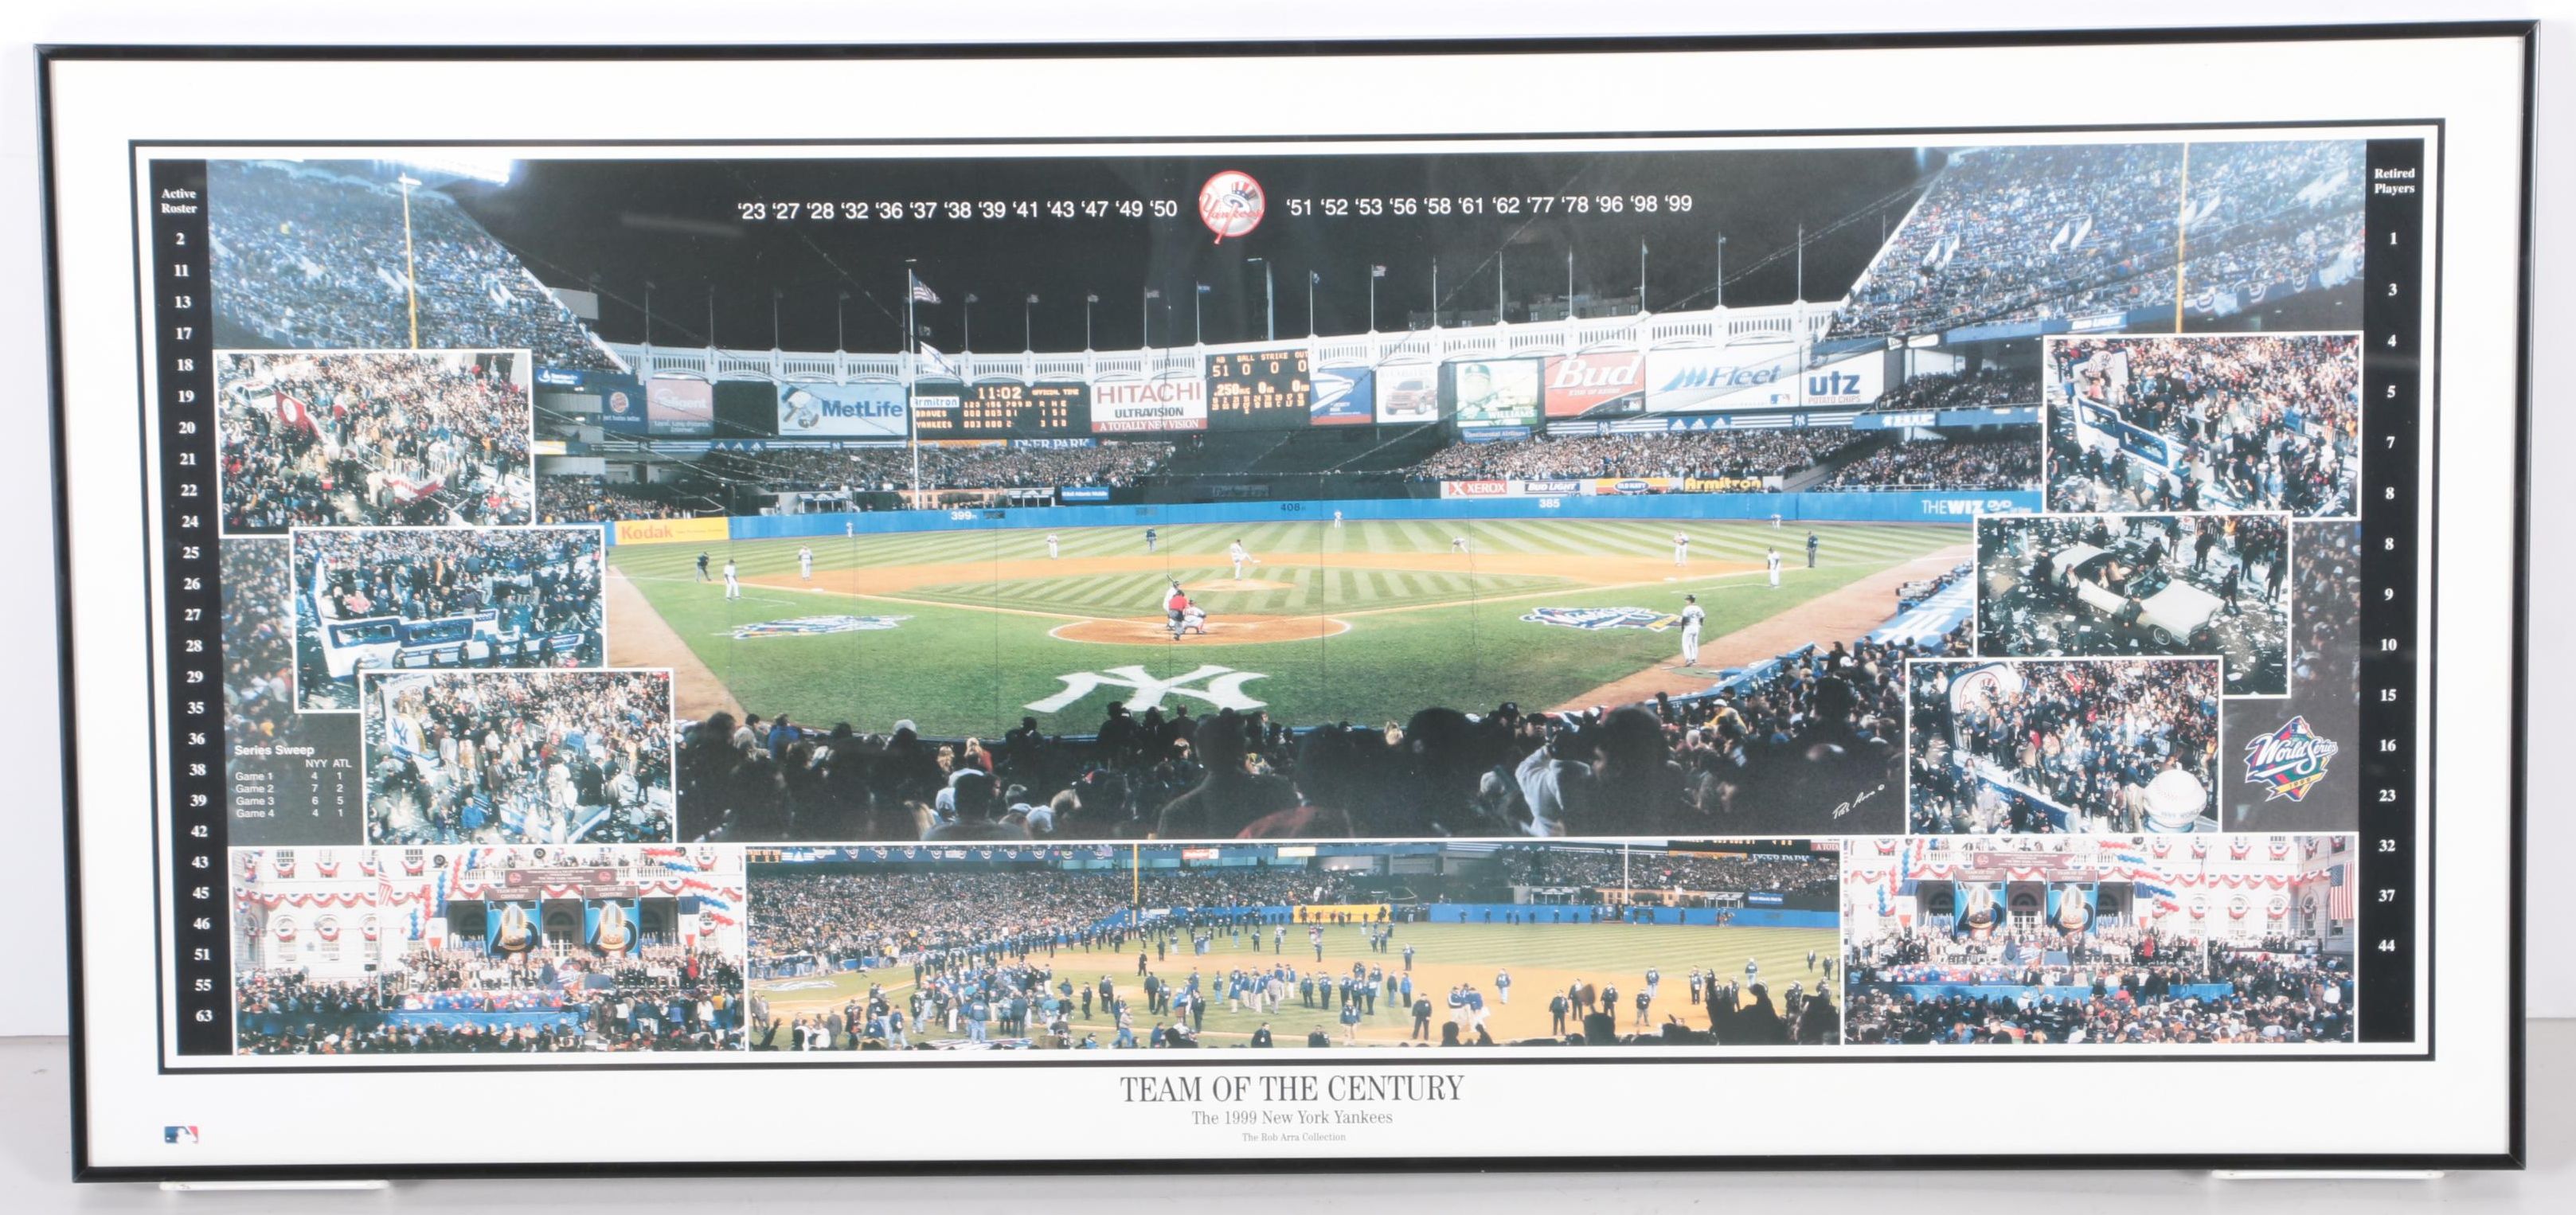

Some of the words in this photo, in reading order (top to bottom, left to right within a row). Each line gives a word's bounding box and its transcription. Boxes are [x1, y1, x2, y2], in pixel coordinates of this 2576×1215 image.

[2374, 167, 2416, 180] Retired
[161, 188, 197, 200] Active
[2374, 182, 2416, 197] Players
[160, 202, 199, 214] Roster
[175, 232, 186, 246] 2
[2390, 232, 2398, 245] 1
[174, 264, 190, 277] 11
[2387, 283, 2398, 297] 3
[174, 295, 192, 309] 13
[176, 326, 193, 341] 17
[2386, 334, 2397, 347] 4
[1261, 352, 1288, 361] STRIKE
[177, 357, 194, 372] 18
[1212, 364, 1229, 377] 51
[1242, 363, 1252, 376] 0
[1270, 361, 1280, 374] 0
[1298, 359, 1308, 373] 0
[1548, 355, 1646, 389] Bud
[1706, 365, 1781, 387] Fleet
[1809, 370, 1861, 396] utz
[178, 389, 195, 403] 19
[978, 387, 1022, 400] 11:02
[1096, 382, 1201, 404] HITACHI
[2386, 385, 2396, 399] 5
[1808, 396, 1835, 404] POTATO
[1838, 395, 1861, 404] CHIPS
[822, 400, 903, 417] MetLife
[1115, 407, 1184, 418] ULTRAVISION
[178, 420, 197, 435] 20
[1100, 423, 1107, 432] A
[1108, 421, 1147, 431] TOTALLY
[1167, 419, 1199, 430] VISION
[2386, 436, 2396, 449] 7
[179, 452, 197, 466] 21
[180, 483, 198, 497] 22
[1467, 482, 1506, 494] XEROX
[1527, 482, 1547, 492] BUD
[1549, 482, 1577, 491] LIGHT
[1685, 477, 1762, 492] Armitron
[2385, 486, 2395, 500] 8
[1538, 498, 1561, 508] 385
[181, 514, 200, 528] 24
[951, 510, 972, 521] 399
[621, 525, 673, 540] Kodak
[2384, 537, 2394, 551] 8
[182, 545, 200, 560] 25
[183, 576, 201, 591] 26
[2384, 588, 2394, 601] 9
[184, 608, 202, 622] 27
[185, 639, 204, 653] 28
[2381, 638, 2398, 651] 10
[186, 670, 205, 684] 29
[2380, 688, 2397, 702] 15
[186, 701, 205, 715] 35
[188, 732, 206, 745] 36
[2380, 739, 2397, 752] 16
[235, 744, 272, 756] Series
[276, 744, 315, 757] Sweep
[2255, 734, 2309, 767] World
[2296, 737, 2338, 775] Series
[189, 763, 207, 776] 38
[306, 759, 328, 768] NYY
[333, 759, 353, 768] ATL
[236, 772, 265, 781] Game
[268, 772, 274, 780] 1
[311, 772, 319, 780] 4
[337, 772, 342, 780] 1
[236, 784, 265, 794] Game
[268, 784, 275, 793] 2
[311, 784, 319, 793] 7
[336, 784, 344, 793] 2
[2379, 788, 2397, 803] 23
[190, 794, 208, 807] 39
[236, 796, 265, 806] Game
[268, 796, 275, 805] 3
[311, 796, 319, 805] 6
[336, 796, 344, 805] 5
[236, 809, 265, 818] Game
[268, 809, 275, 818] 4
[311, 809, 319, 818] 4
[338, 809, 343, 818] 1
[190, 825, 209, 838] 42
[2378, 838, 2396, 853] 32
[191, 855, 209, 869] 43
[192, 886, 210, 900] 45
[2378, 889, 2396, 902] 37
[193, 917, 211, 930] 46
[2378, 939, 2396, 952] 44
[193, 947, 211, 961] 51
[194, 979, 213, 992] 55
[195, 1009, 213, 1022] 63
[1120, 1076, 1202, 1103] TEAM
[1212, 1076, 1251, 1102] OF
[1259, 1076, 1318, 1101] THE
[1327, 1075, 1465, 1101] CENTURY
[1192, 1111, 1218, 1125] The
[1225, 1111, 1257, 1124] 1999
[1262, 1111, 1292, 1123] New
[1297, 1110, 1330, 1124] York
[1334, 1110, 1393, 1124] Yankees
[1241, 1132, 1259, 1142] The
[1261, 1132, 1278, 1141] Rob
[1302, 1132, 1347, 1141] Collection
